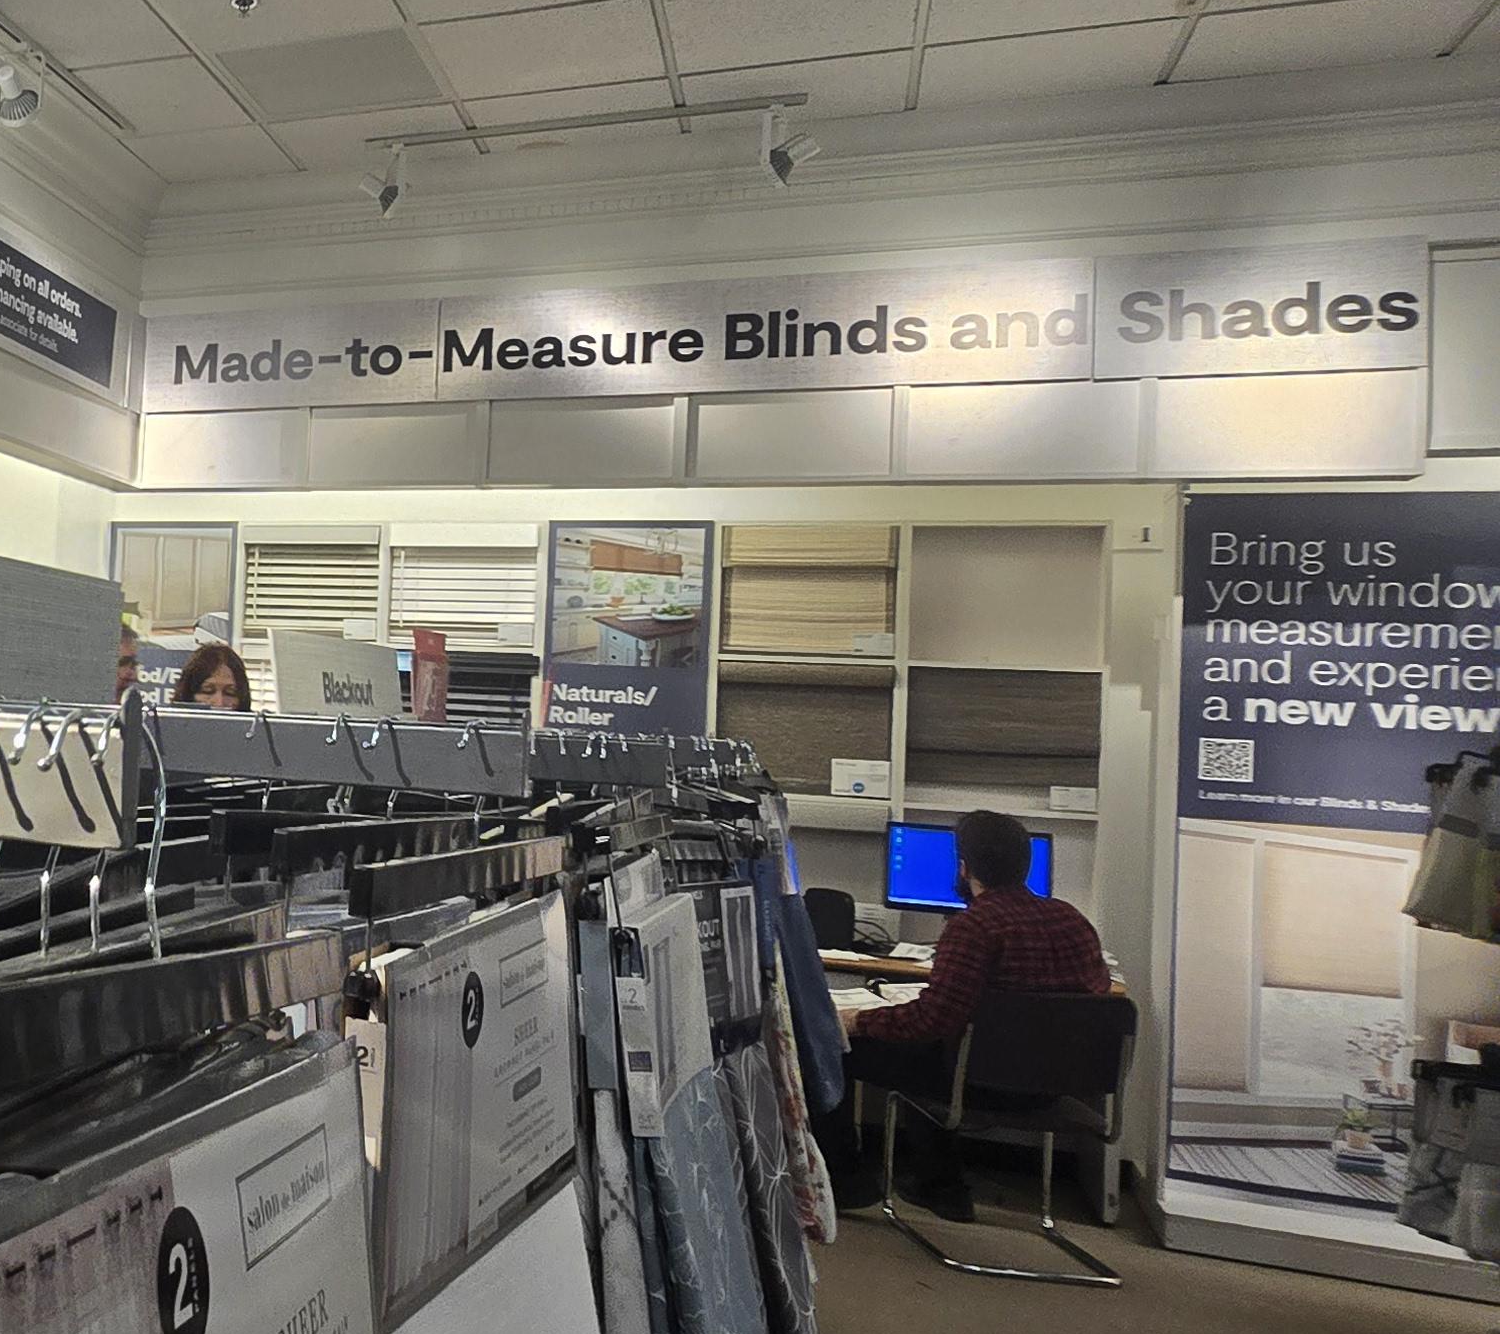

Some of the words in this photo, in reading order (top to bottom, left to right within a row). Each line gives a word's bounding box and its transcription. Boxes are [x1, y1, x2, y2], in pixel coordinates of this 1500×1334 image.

[23, 273, 36, 292] on
[37, 280, 50, 299] all
[50, 287, 82, 318] orders.
[37, 310, 79, 344] available.
[172, 326, 704, 385] Made-to-Measure
[724, 304, 928, 362] Blinds
[950, 293, 1089, 351] and
[1117, 280, 1420, 344] Shades
[1210, 532, 1327, 575] Bring
[1343, 540, 1397, 567] us
[1205, 579, 1313, 613] your
[1205, 619, 1500, 651] measureme
[322, 671, 375, 705] Blackout
[1204, 650, 1292, 684] and
[1309, 657, 1500, 697] experie
[552, 682, 658, 706] Naturals/
[549, 705, 615, 726] Roller
[1202, 696, 1232, 721] a
[1244, 697, 1357, 727] new
[1319, 796, 1363, 810] Blinds
[1366, 799, 1378, 811] &
[467, 988, 476, 1030] 2
[628, 987, 637, 1004] 2
[357, 1046, 368, 1067] 2
[169, 1242, 194, 1330] 2
